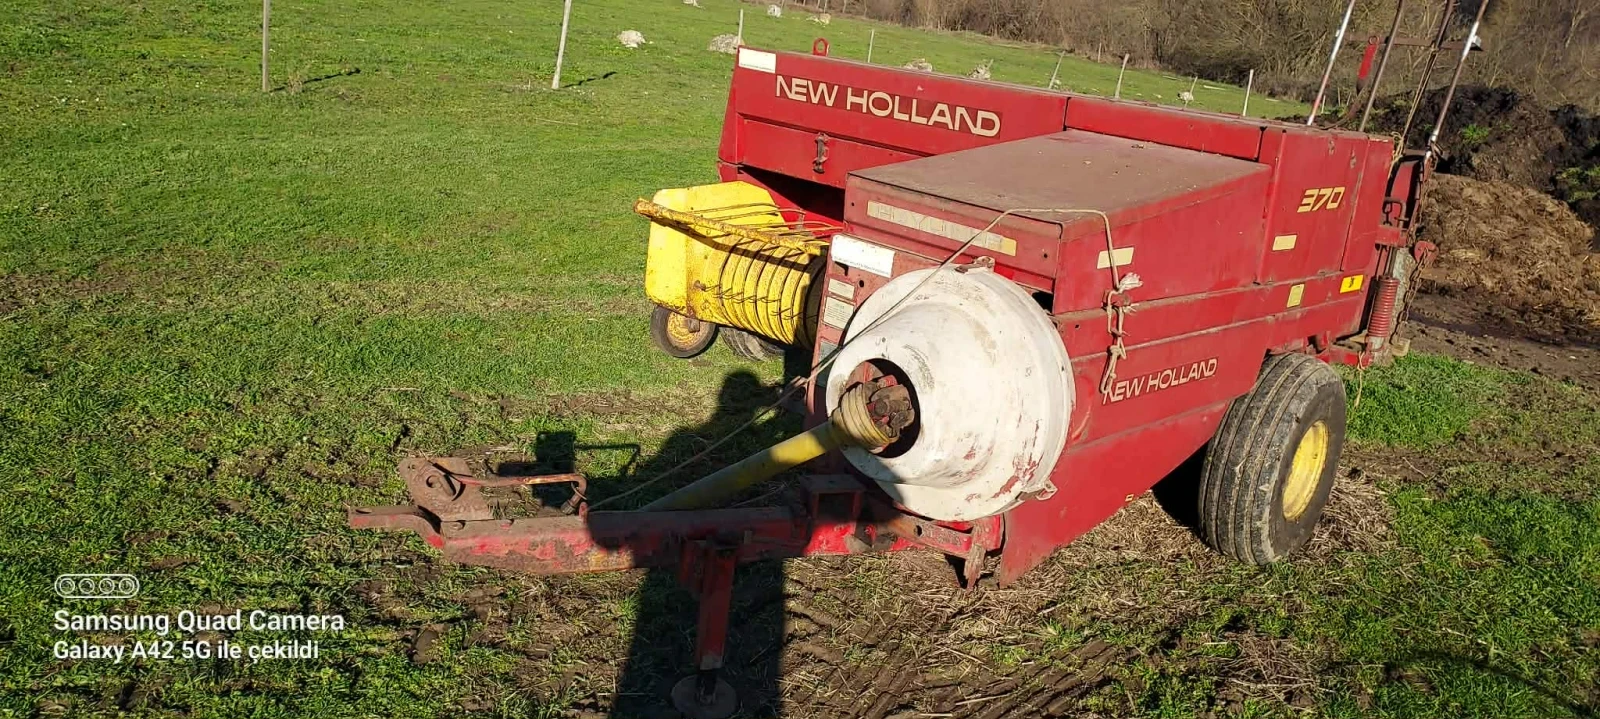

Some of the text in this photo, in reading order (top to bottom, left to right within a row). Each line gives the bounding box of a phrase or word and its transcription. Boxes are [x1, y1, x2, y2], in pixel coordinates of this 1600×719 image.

[775, 75, 1001, 137] NEW HOLLAND
[1297, 186, 1345, 213] 370
[1102, 358, 1218, 405] NEW HOLLAND
